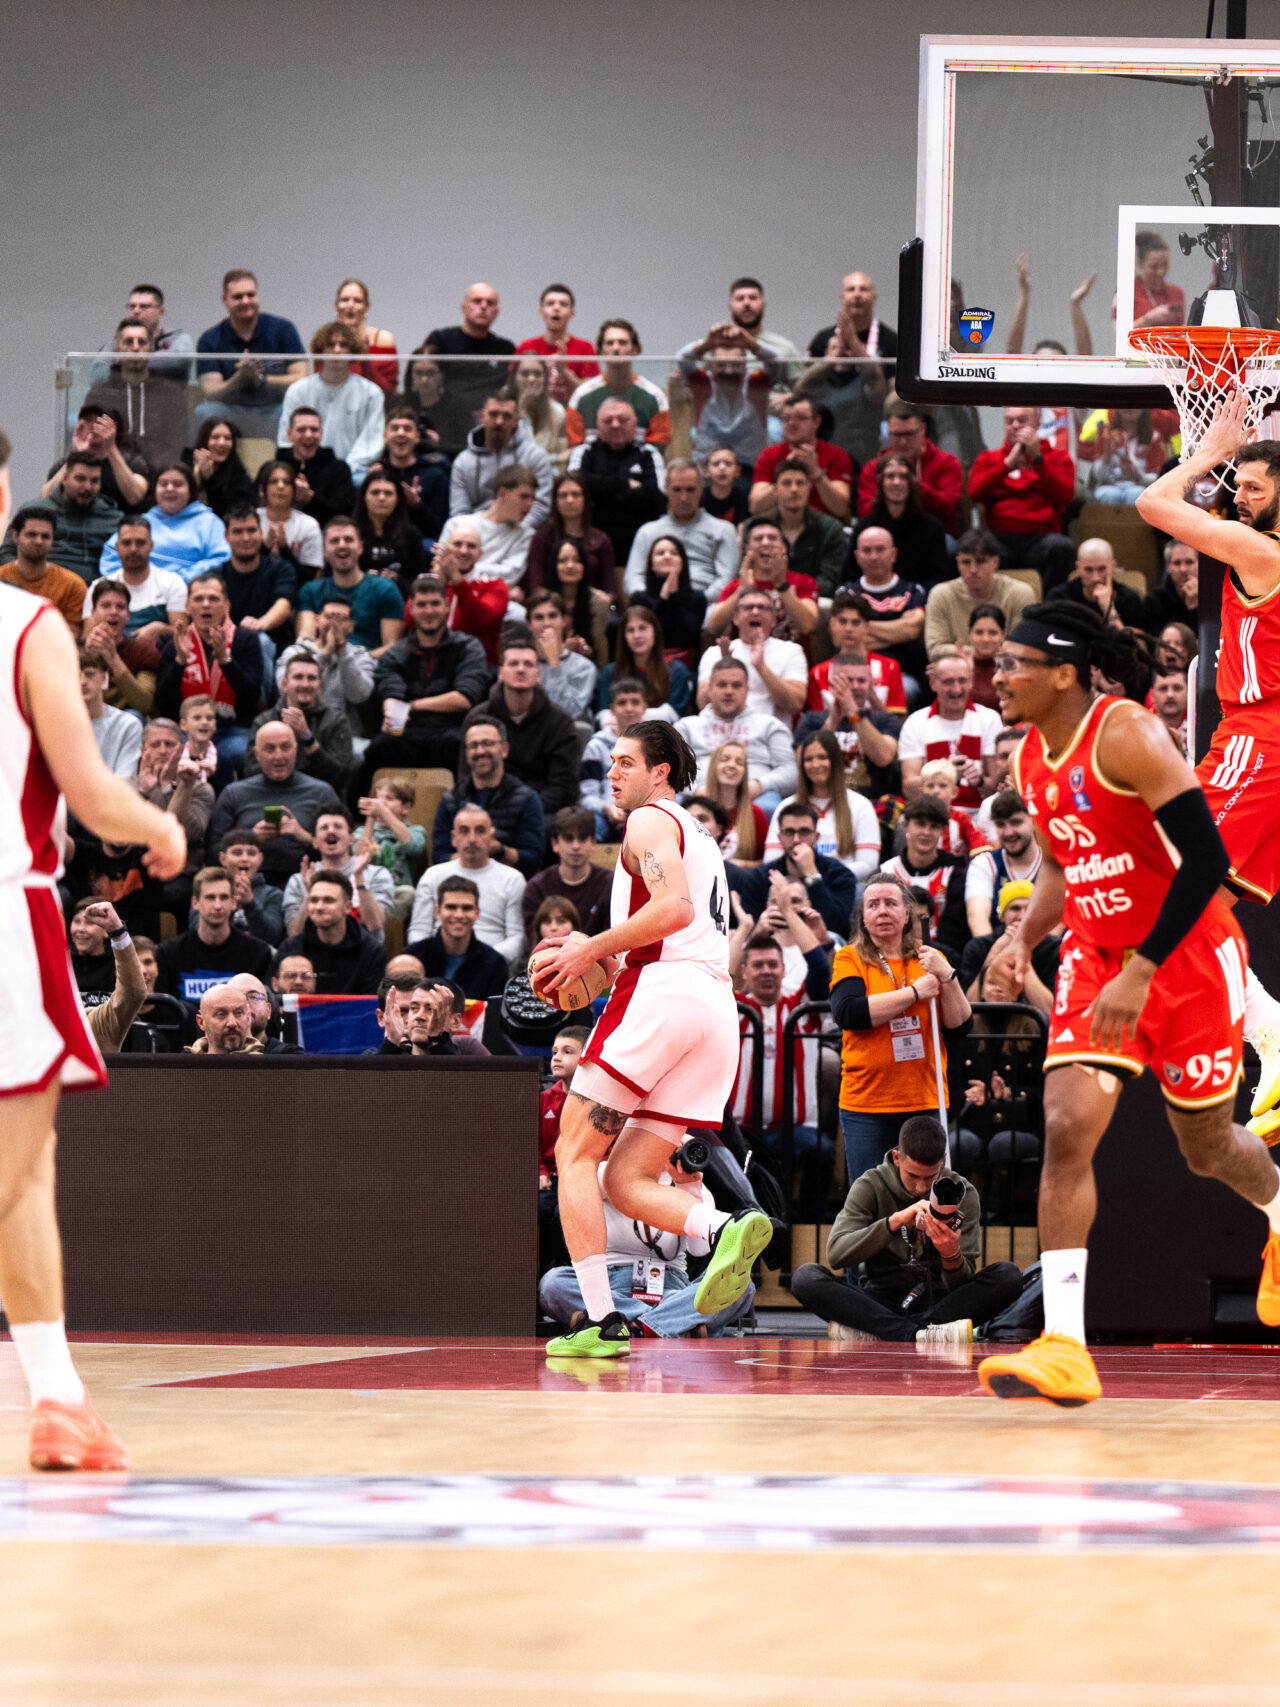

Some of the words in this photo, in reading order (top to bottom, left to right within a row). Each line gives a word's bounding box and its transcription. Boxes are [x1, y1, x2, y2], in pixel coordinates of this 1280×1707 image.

[970, 320, 982, 330] ABA
[937, 365, 996, 380] SPALDING
[1249, 751, 1266, 776] WEST
[1048, 814, 1097, 851] 95
[1064, 851, 1135, 884] eridian
[1186, 1046, 1233, 1091] 95
